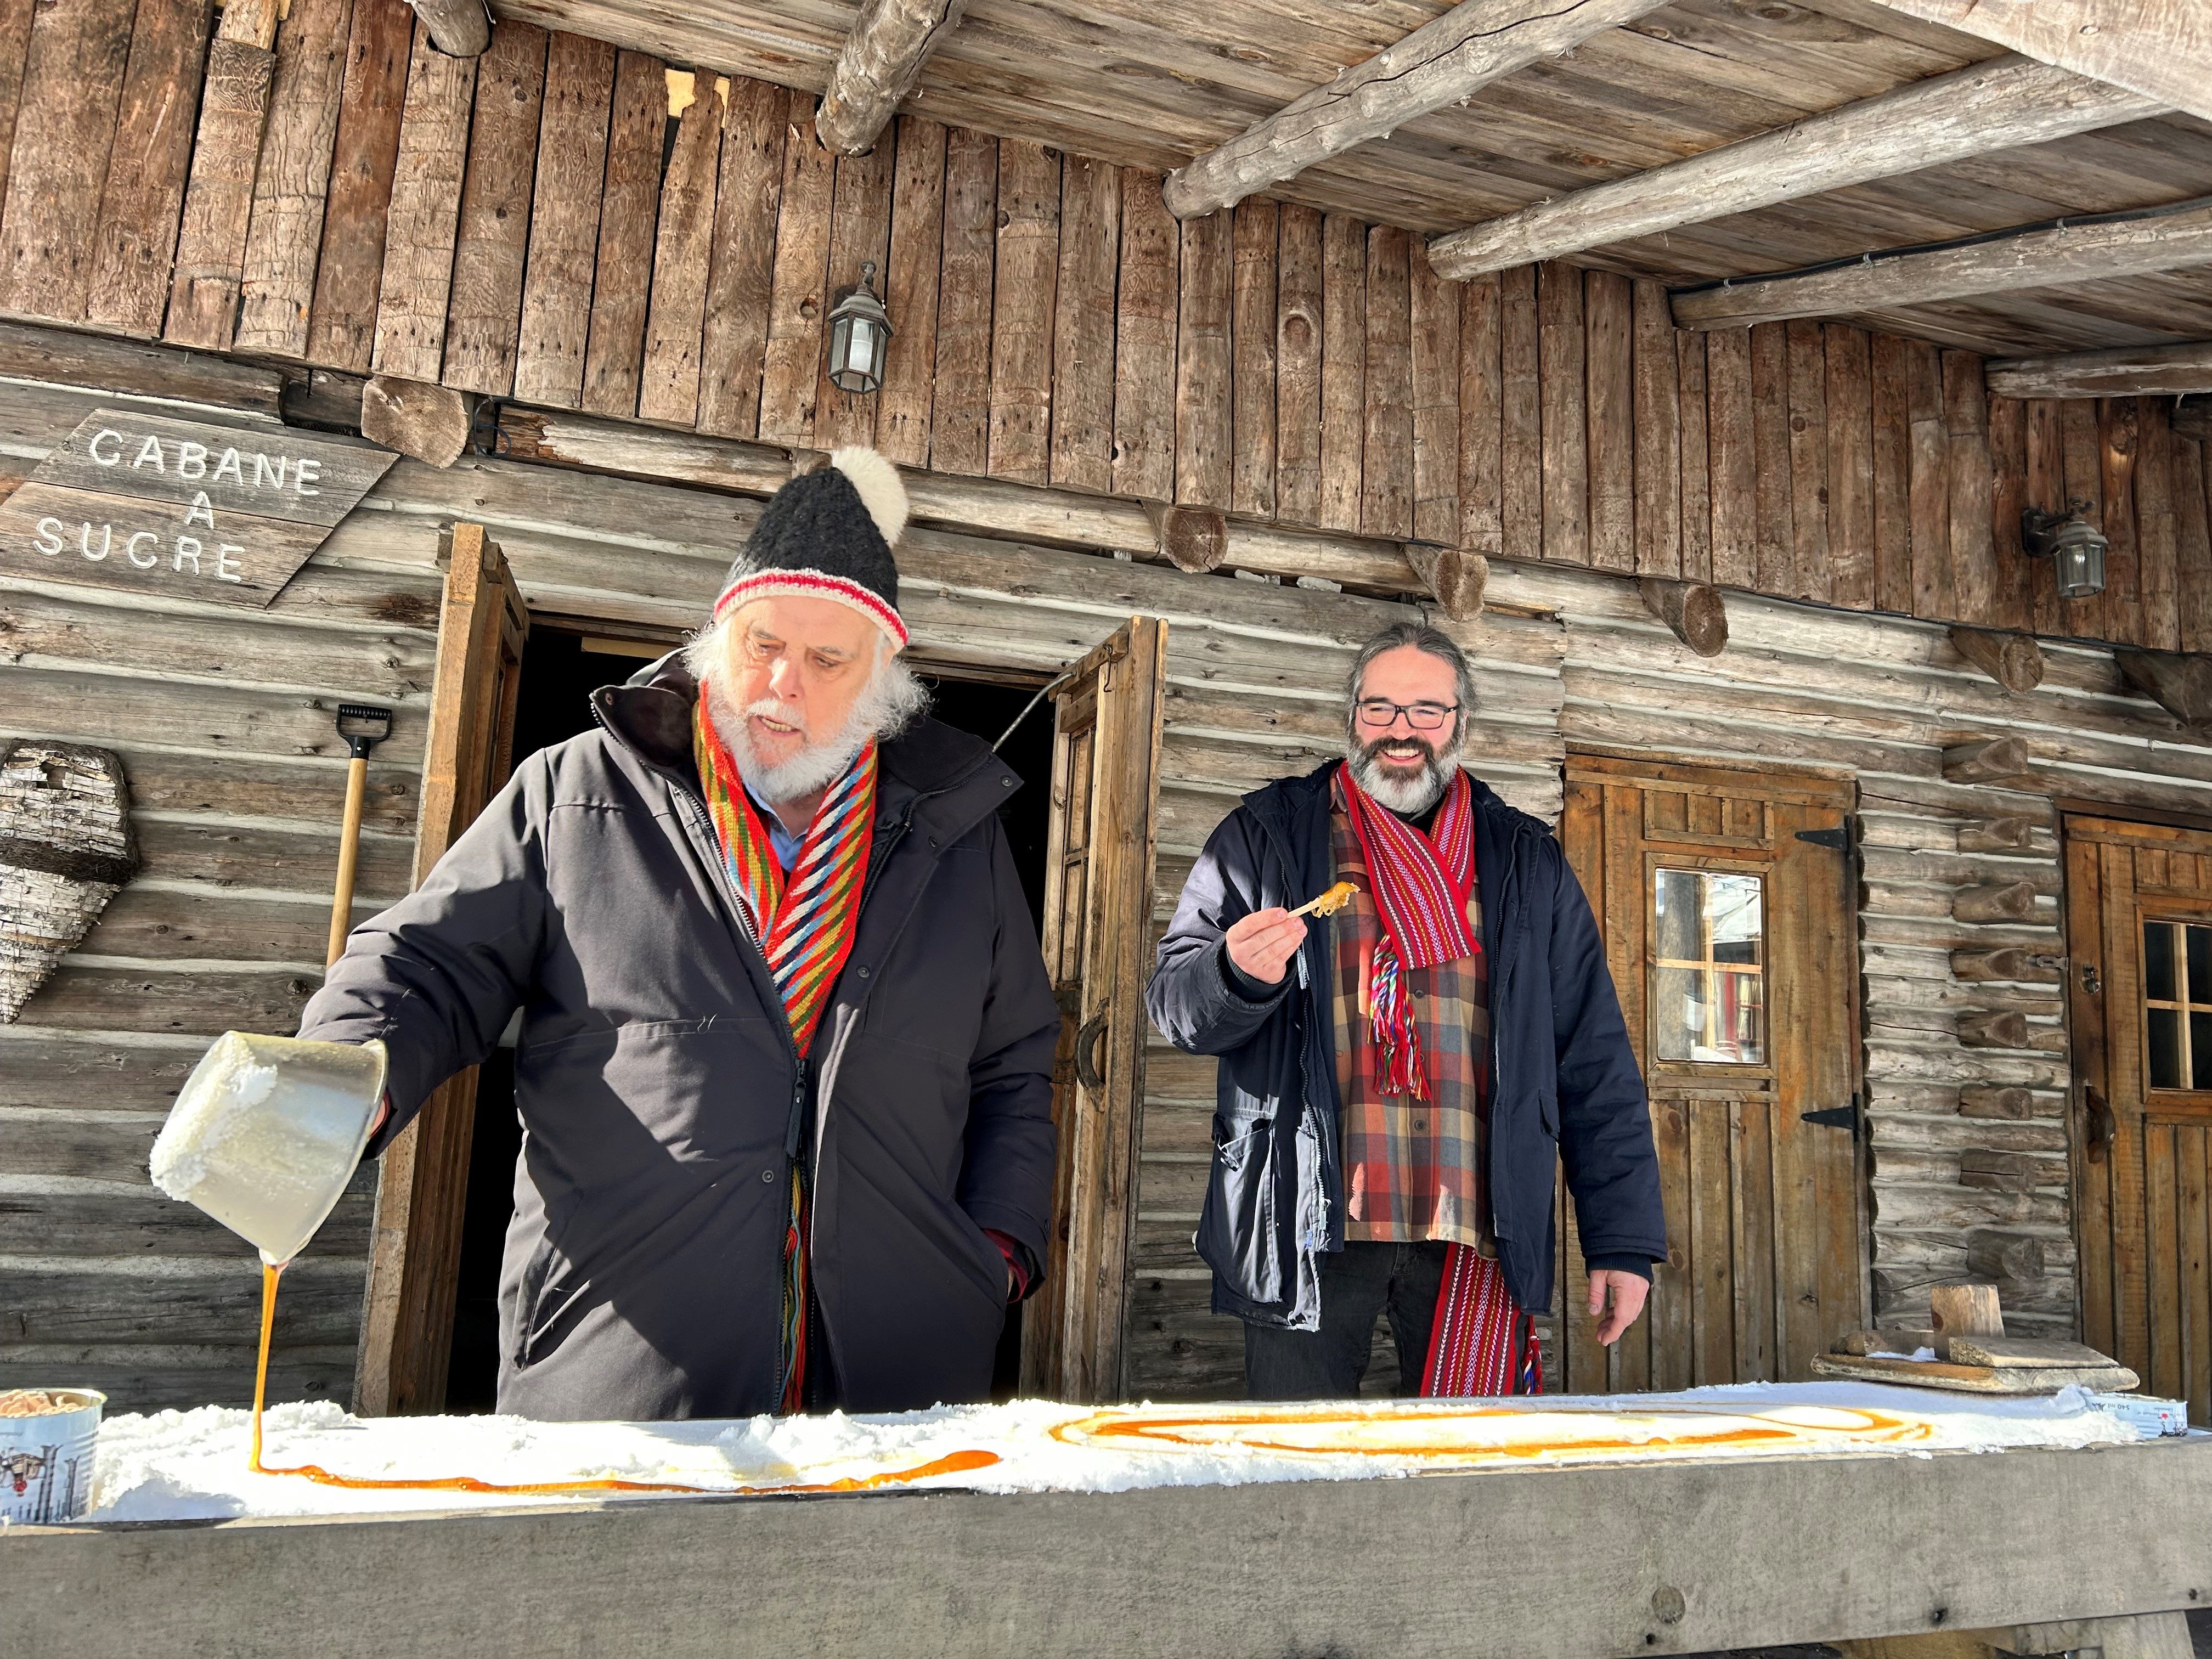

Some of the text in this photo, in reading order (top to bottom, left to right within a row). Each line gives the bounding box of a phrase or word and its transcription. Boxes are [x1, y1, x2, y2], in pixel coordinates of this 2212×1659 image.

[89, 429, 323, 495] CABANE
[184, 491, 215, 529] A
[33, 517, 245, 583] SUCRE
